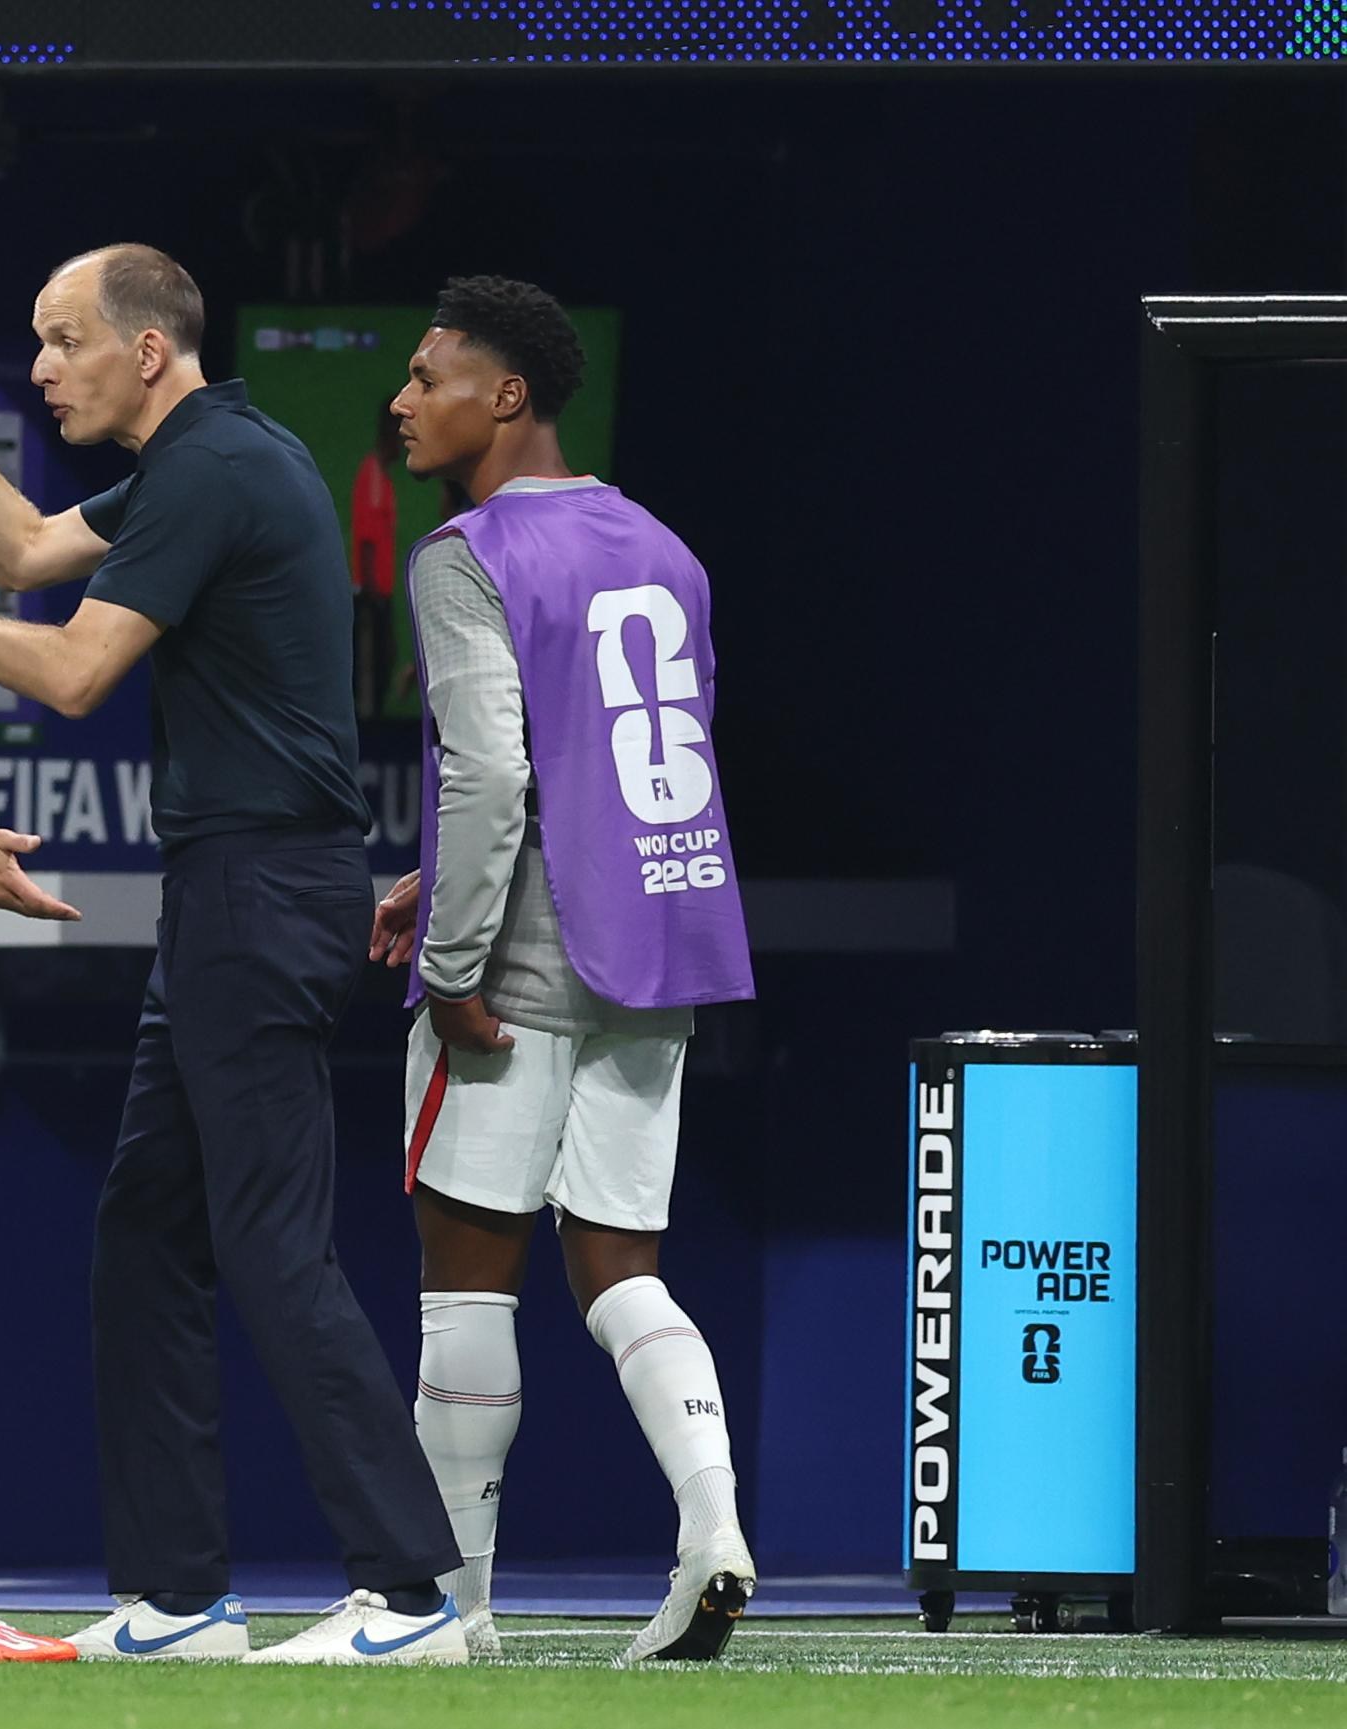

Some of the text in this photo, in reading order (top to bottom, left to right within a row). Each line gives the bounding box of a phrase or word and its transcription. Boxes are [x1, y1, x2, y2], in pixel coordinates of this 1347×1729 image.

[670, 829, 720, 853] CUP
[981, 1240, 1111, 1270] POWER
[1037, 1272, 1110, 1302] ADE
[913, 1082, 954, 1560] POWERADE
[683, 1399, 719, 1417] ENG
[481, 1479, 500, 1500] EN
[224, 1600, 243, 1616] NIK
